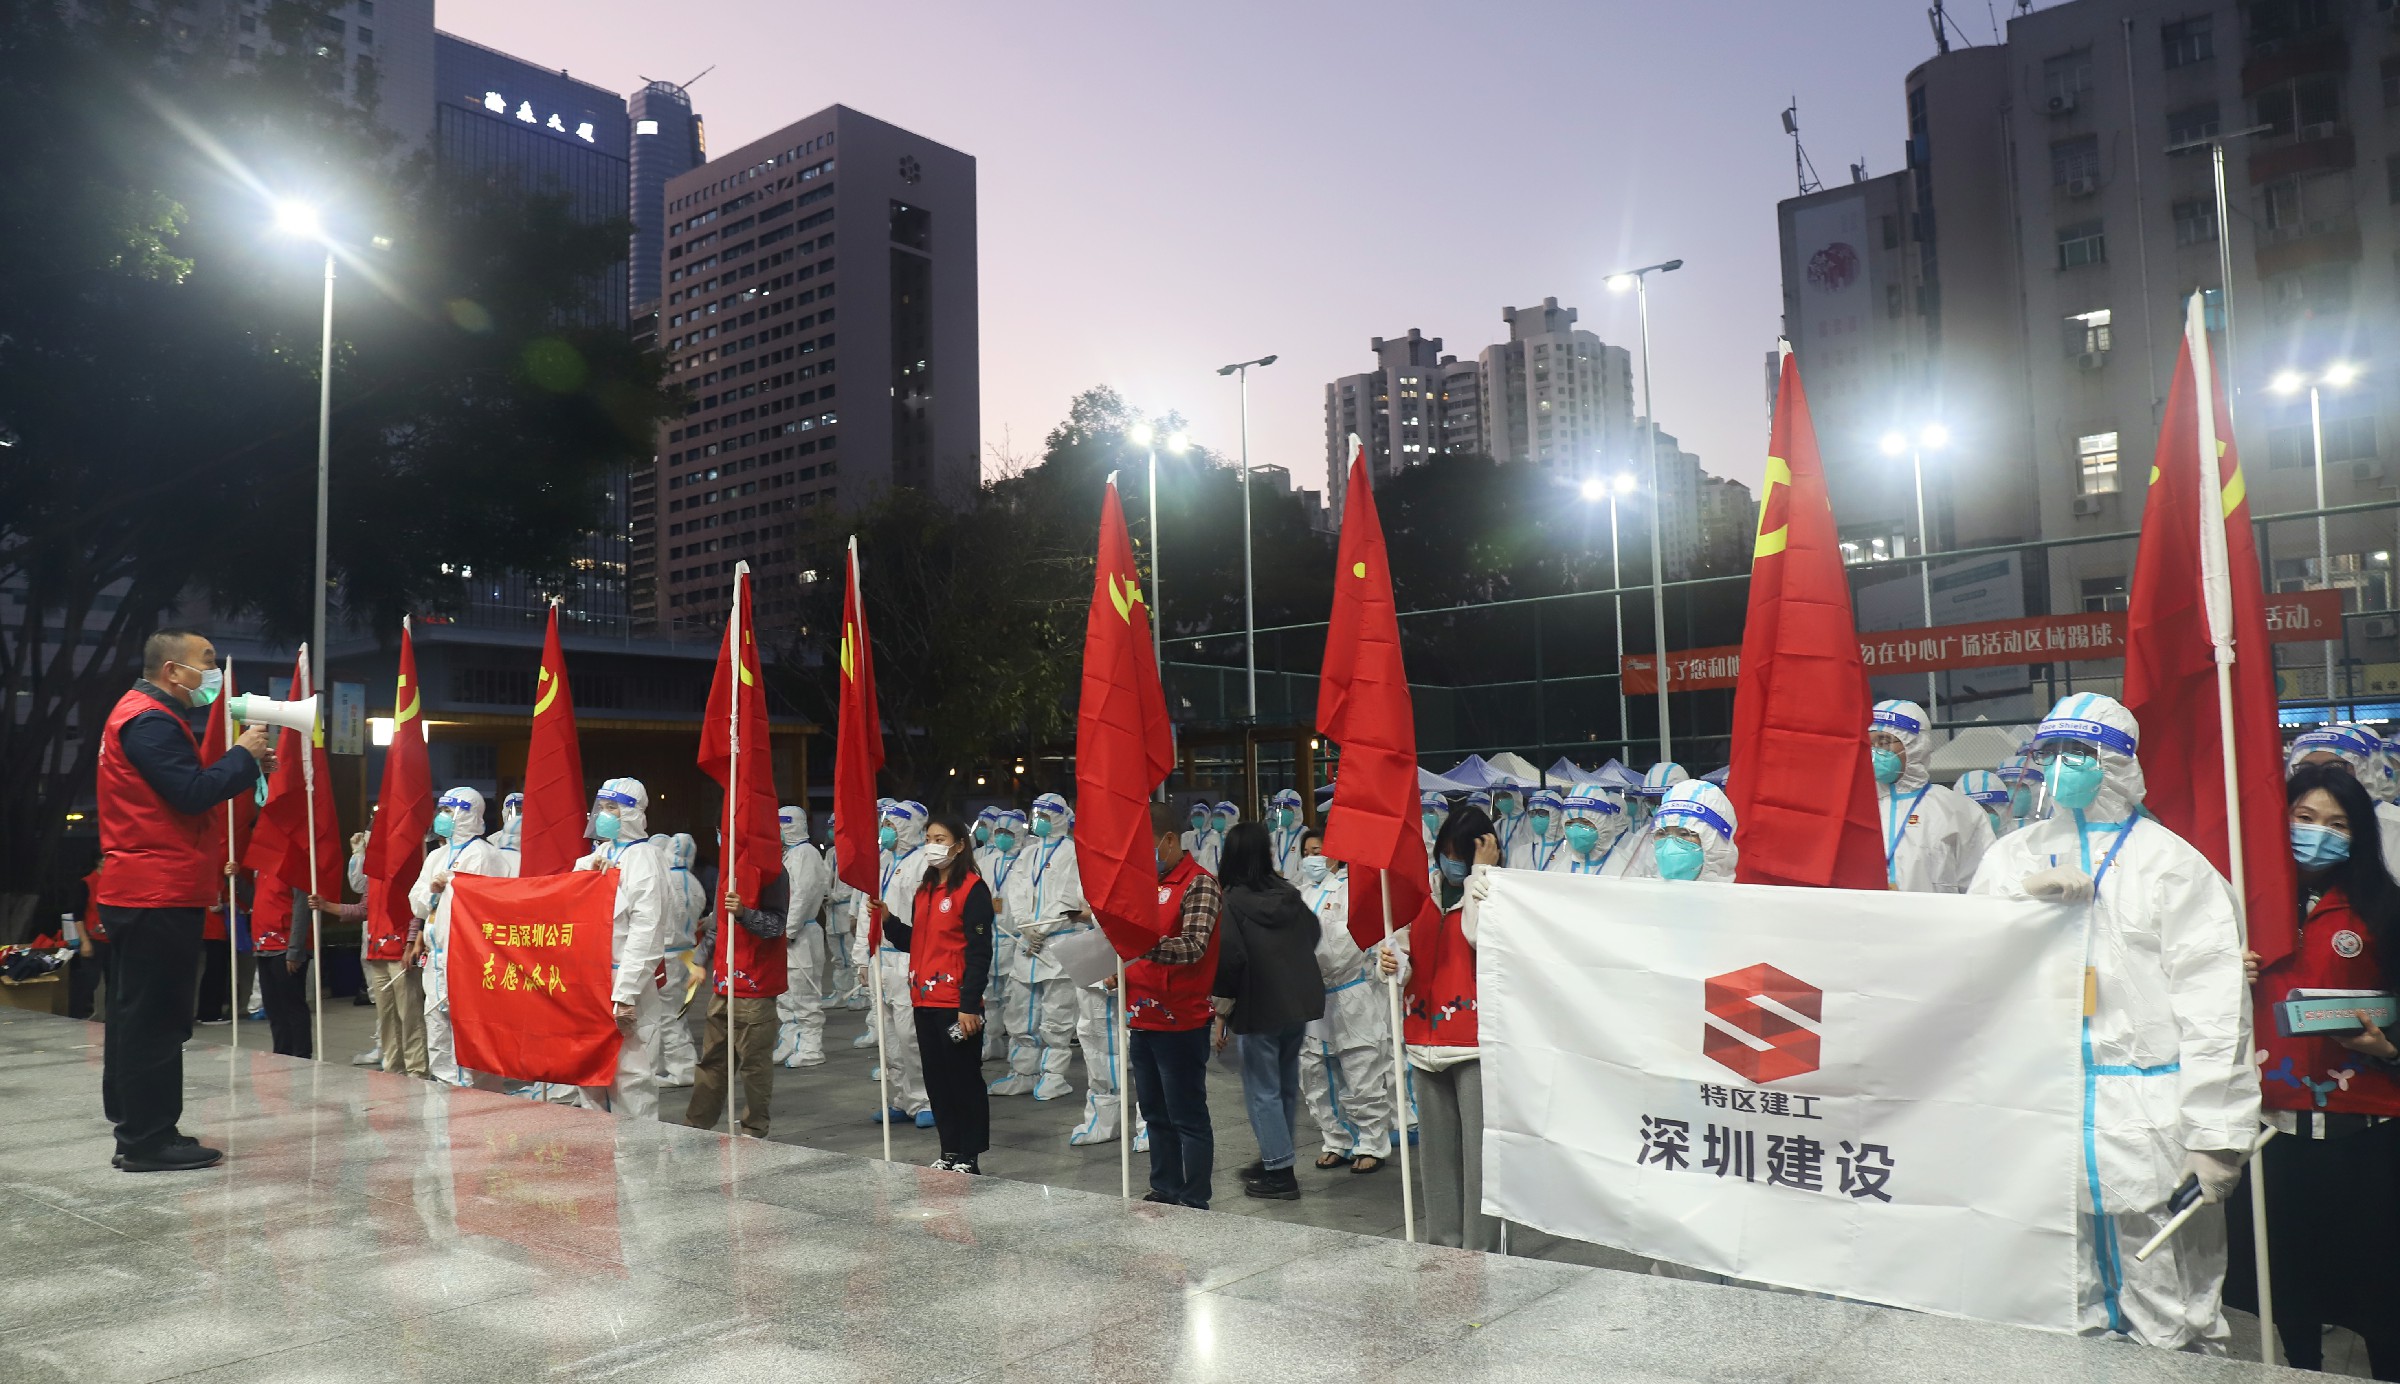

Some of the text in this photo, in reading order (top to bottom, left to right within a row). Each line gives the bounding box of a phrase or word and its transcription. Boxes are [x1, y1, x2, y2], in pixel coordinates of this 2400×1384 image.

[1666, 655, 1741, 683] 了您和他
[2059, 722, 2089, 731] Shield
[1700, 1083, 1823, 1120] 特区建工
[1636, 1113, 1896, 1205] 深圳建设
